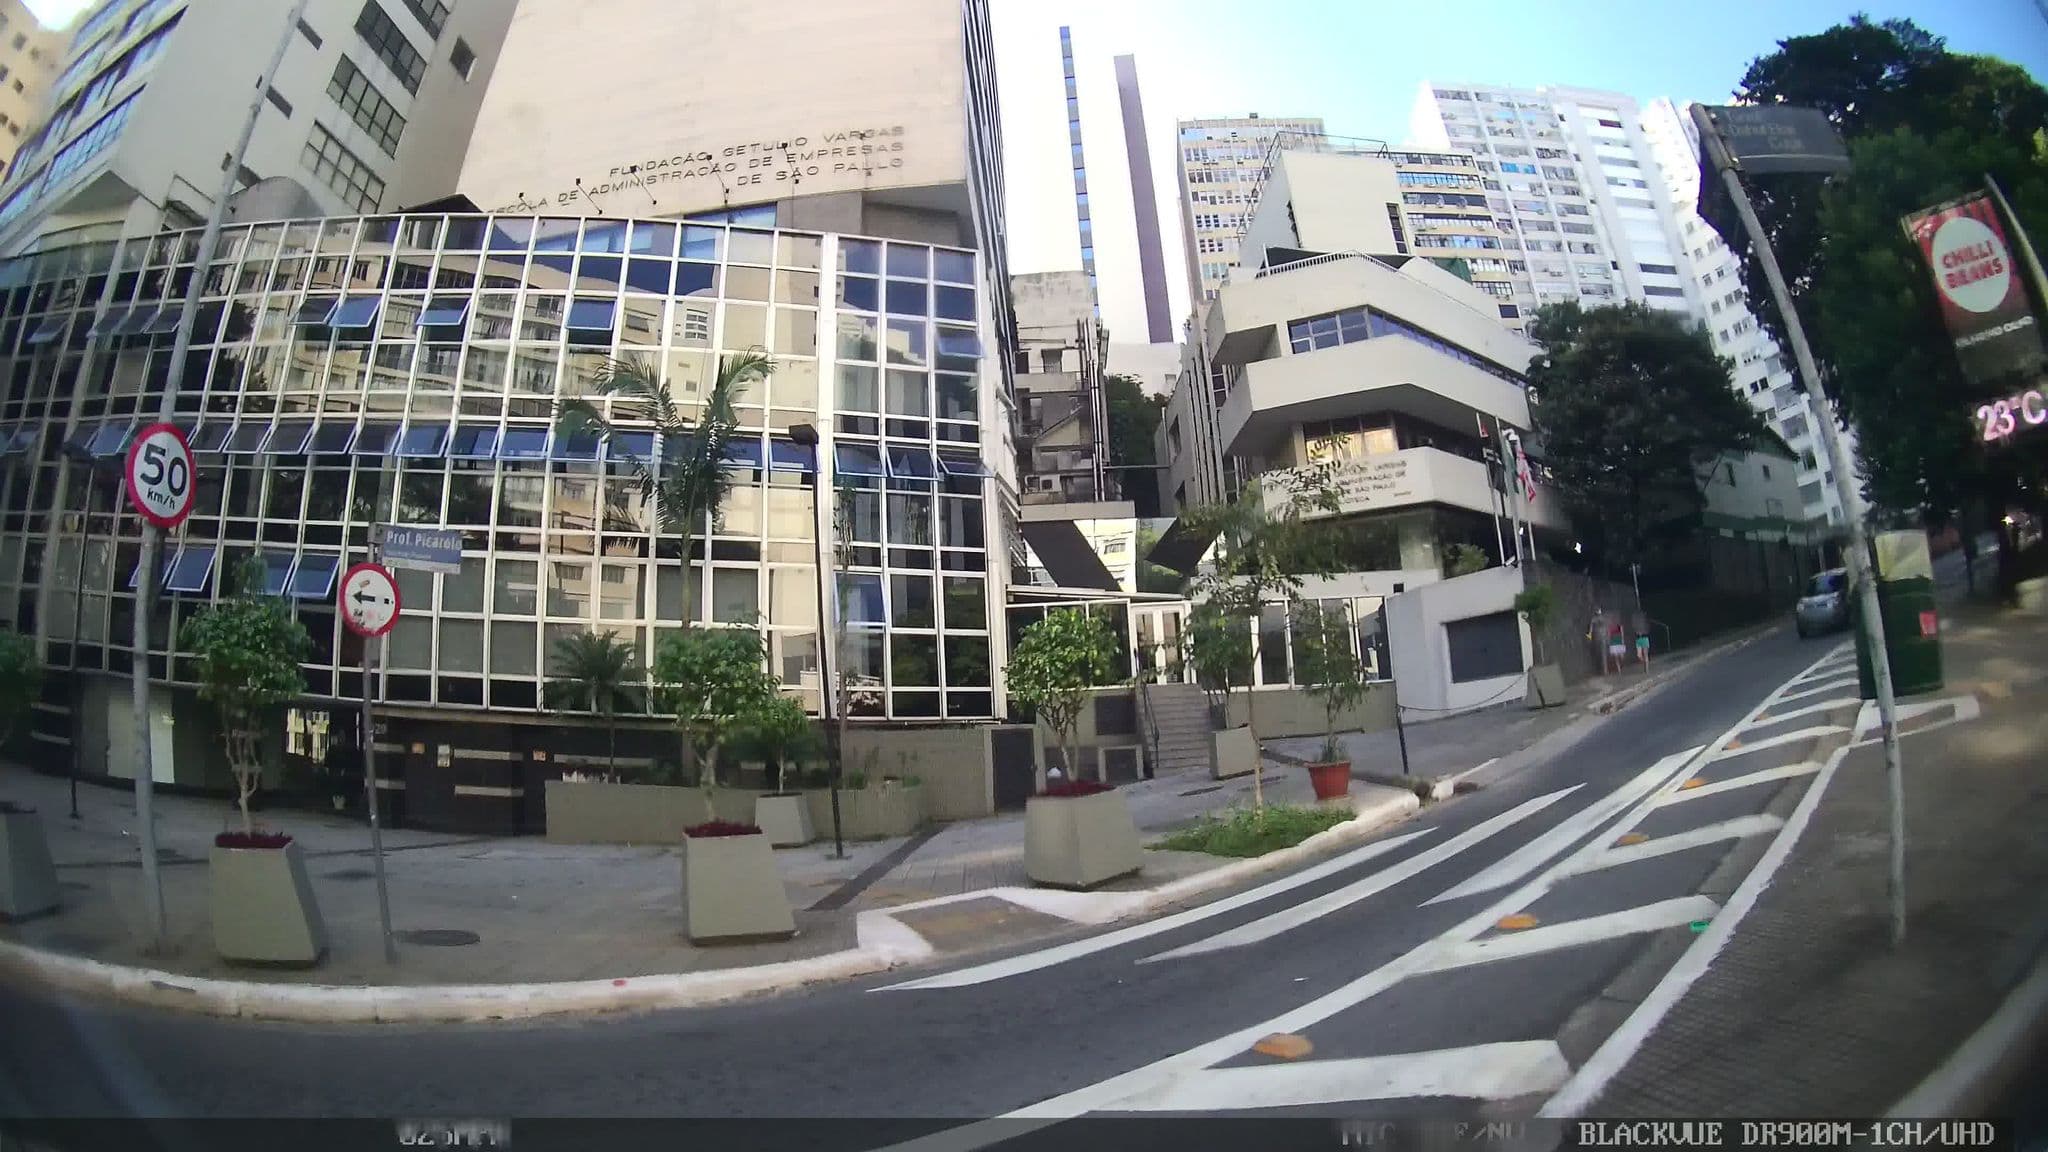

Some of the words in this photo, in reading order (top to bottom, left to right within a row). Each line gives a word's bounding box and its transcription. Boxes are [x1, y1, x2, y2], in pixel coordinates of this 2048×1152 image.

[824, 125, 905, 144] VARGAS
[557, 189, 579, 203] DE
[749, 156, 773, 169] DE
[787, 142, 904, 163] EMPRESAS
[737, 173, 762, 186] DE
[1942, 239, 1993, 269] CHILLI
[1945, 257, 2004, 289] BEANS
[140, 443, 188, 497] 50
[147, 488, 176, 510] km/h
